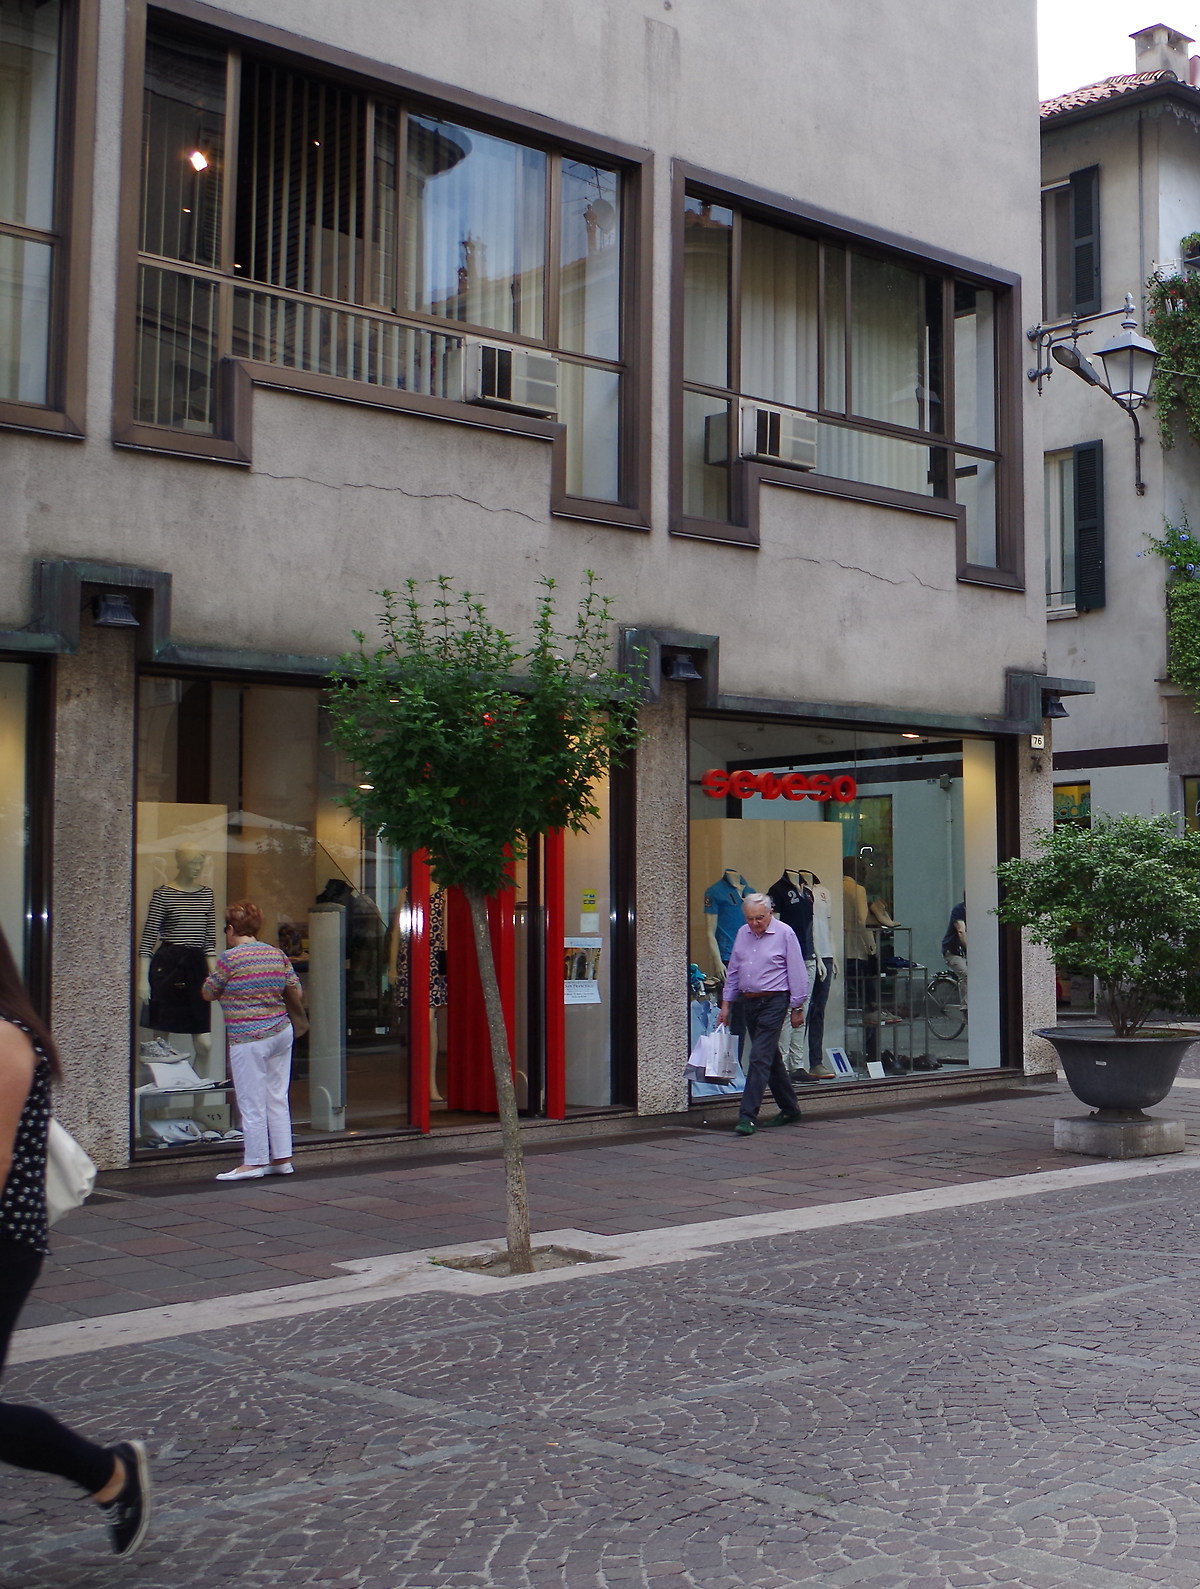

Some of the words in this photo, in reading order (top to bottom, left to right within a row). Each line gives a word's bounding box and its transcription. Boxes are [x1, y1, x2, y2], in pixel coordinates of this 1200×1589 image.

[1033, 736, 1043, 746] 76
[1031, 756, 1043, 773] 76
[788, 890, 800, 905] 2
